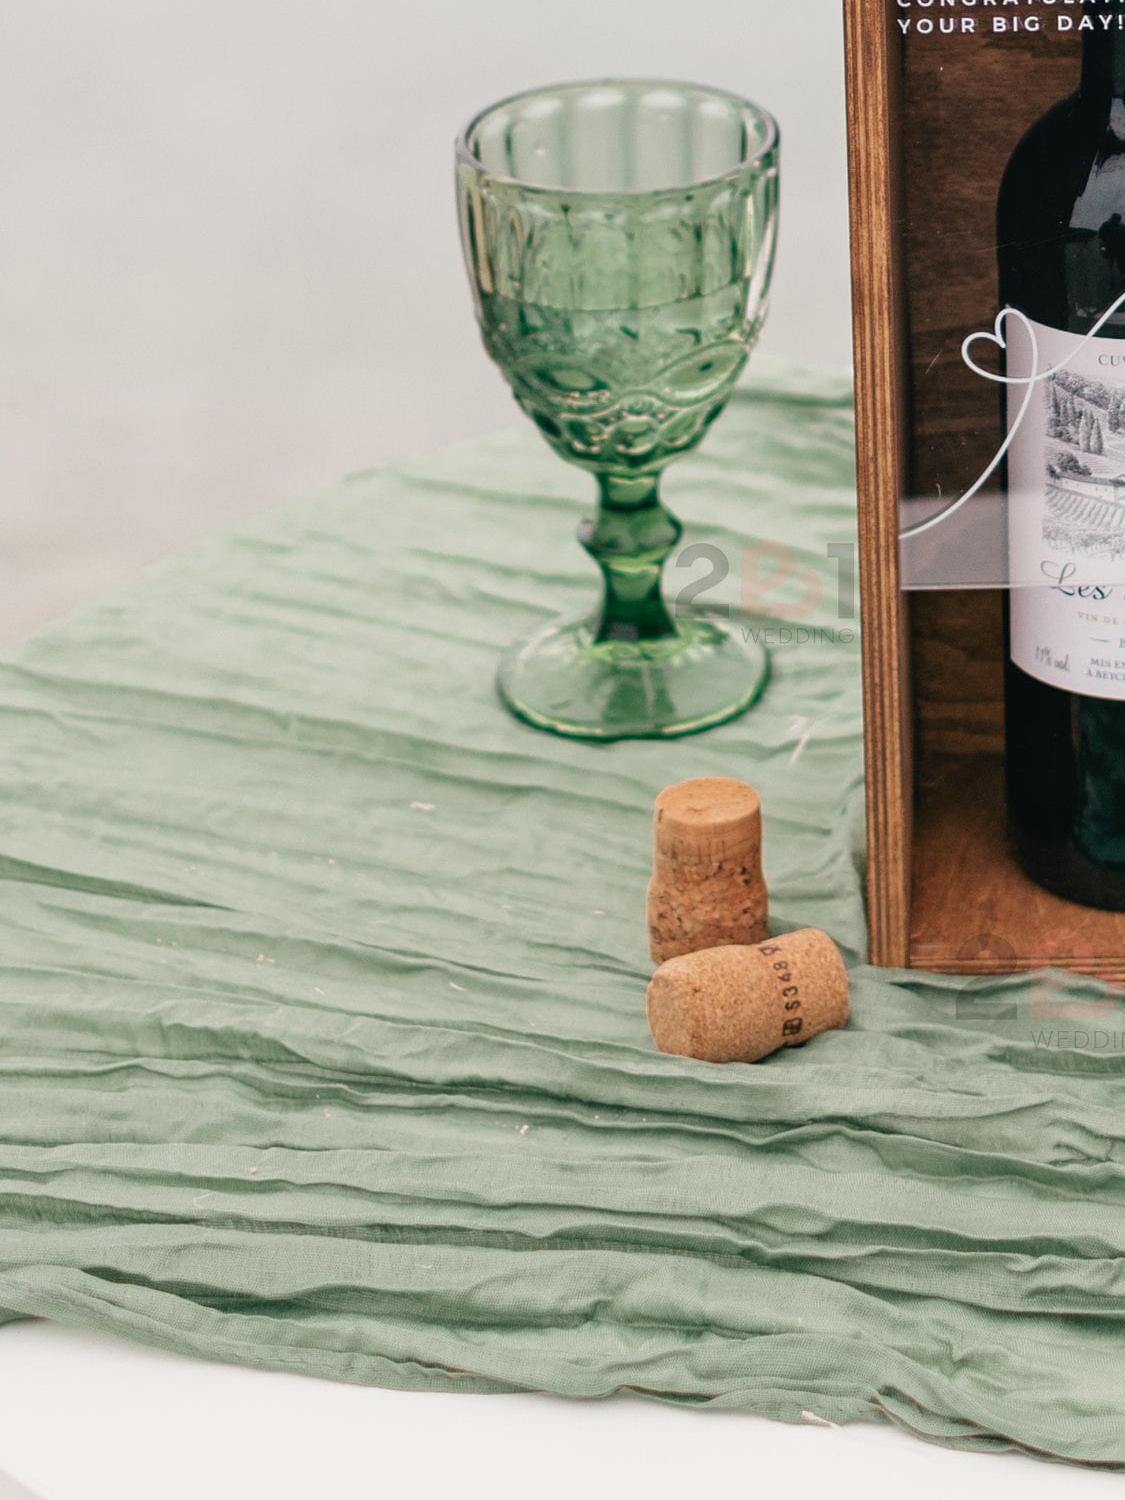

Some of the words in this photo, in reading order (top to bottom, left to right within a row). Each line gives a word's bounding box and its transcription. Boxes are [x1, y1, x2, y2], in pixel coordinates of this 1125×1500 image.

[897, 17, 976, 34] YOUR
[992, 16, 1041, 33] BIG
[1057, 14, 1125, 31] DAY!
[1039, 560, 1113, 601] Les
[1077, 611, 1098, 622] VIN
[1103, 616, 1118, 625] DE
[1090, 657, 1111, 668] MIS
